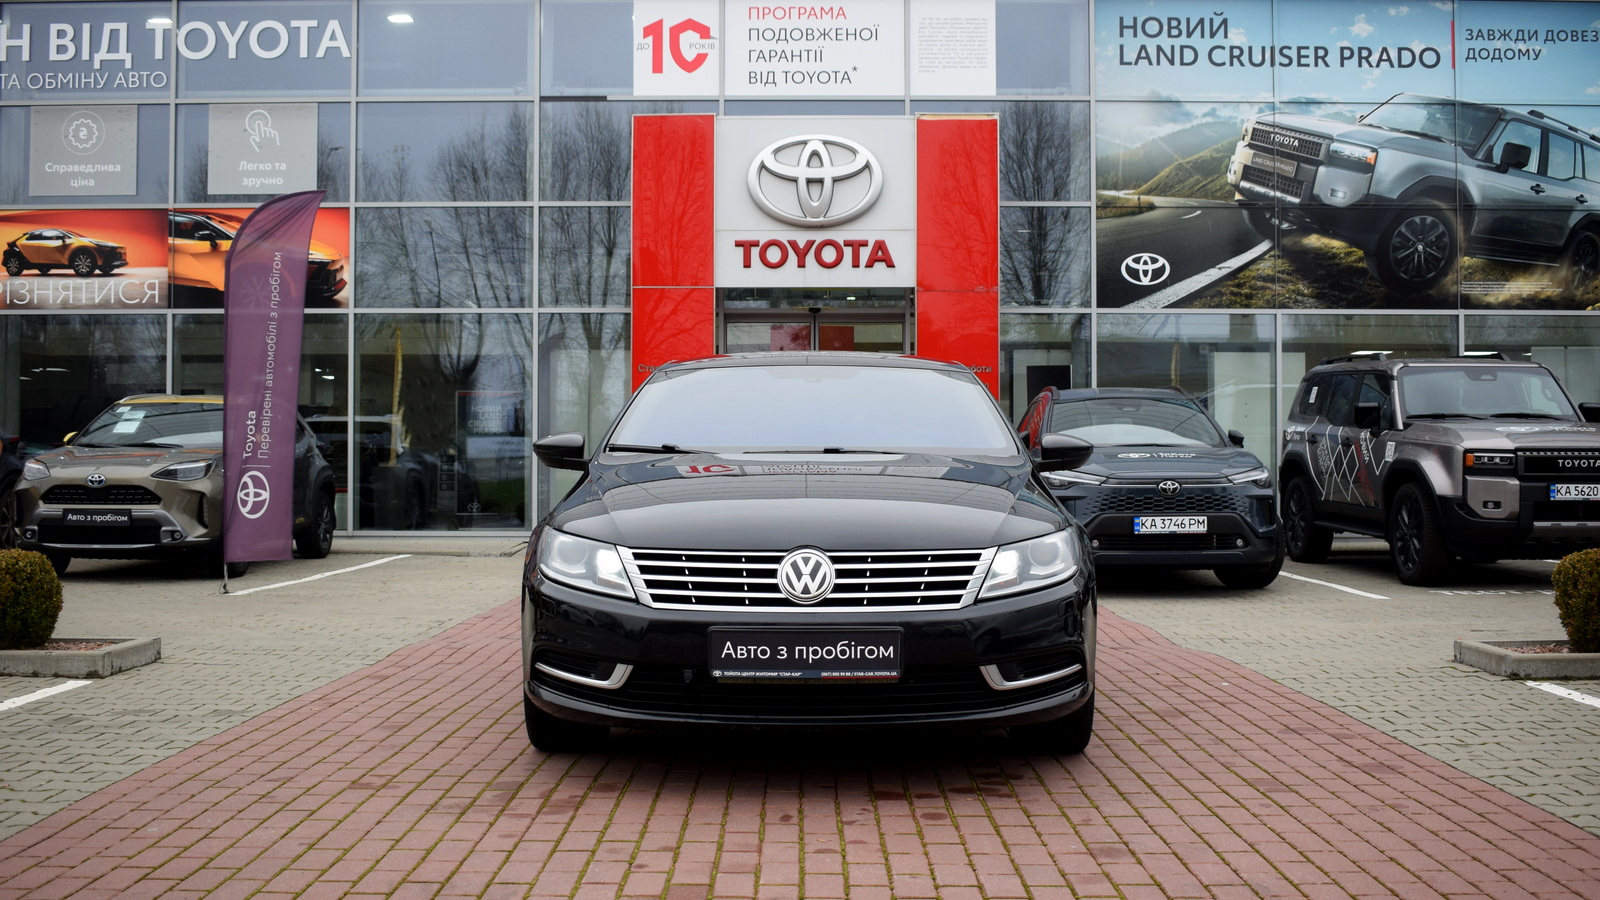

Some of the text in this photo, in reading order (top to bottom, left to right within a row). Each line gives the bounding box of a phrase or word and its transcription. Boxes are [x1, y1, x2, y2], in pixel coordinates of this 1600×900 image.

[748, 6, 847, 20] ПРОГРАМА
[748, 24, 879, 42] ПОДОВЖЕНОЇ
[1119, 11, 1229, 39] НОВИЙ
[1465, 28, 1539, 42] ЗАВЖДИ
[49, 22, 133, 69] ВІД
[146, 19, 352, 60] TOYOTA
[636, 43, 650, 51] ДО
[748, 46, 824, 63] ГАРАНТІЇ
[1119, 44, 1442, 69] LAND CRUISER PRADO
[1465, 48, 1542, 63] ДОДОМУ
[27, 71, 109, 90] ОБМІНУ
[113, 71, 167, 88] АВТО
[748, 70, 777, 87] ВІД
[1270, 133, 1299, 147] TOYOTA
[45, 162, 121, 174] Справедлива
[239, 161, 287, 171] Легко та
[70, 176, 95, 188] ціна
[241, 177, 283, 187] зручно
[734, 238, 896, 269] TOYOTA
[269, 252, 282, 309] пробігом
[265, 321, 277, 387] автомобілі
[257, 391, 273, 459] Перевірені
[242, 410, 256, 459] Toyota
[1556, 486, 1599, 497] KA 5620
[67, 513, 85, 521] Авто
[92, 513, 128, 522] пробігом
[1141, 518, 1206, 529] KA 3746 PM
[721, 641, 894, 664] Авто з пробігом
